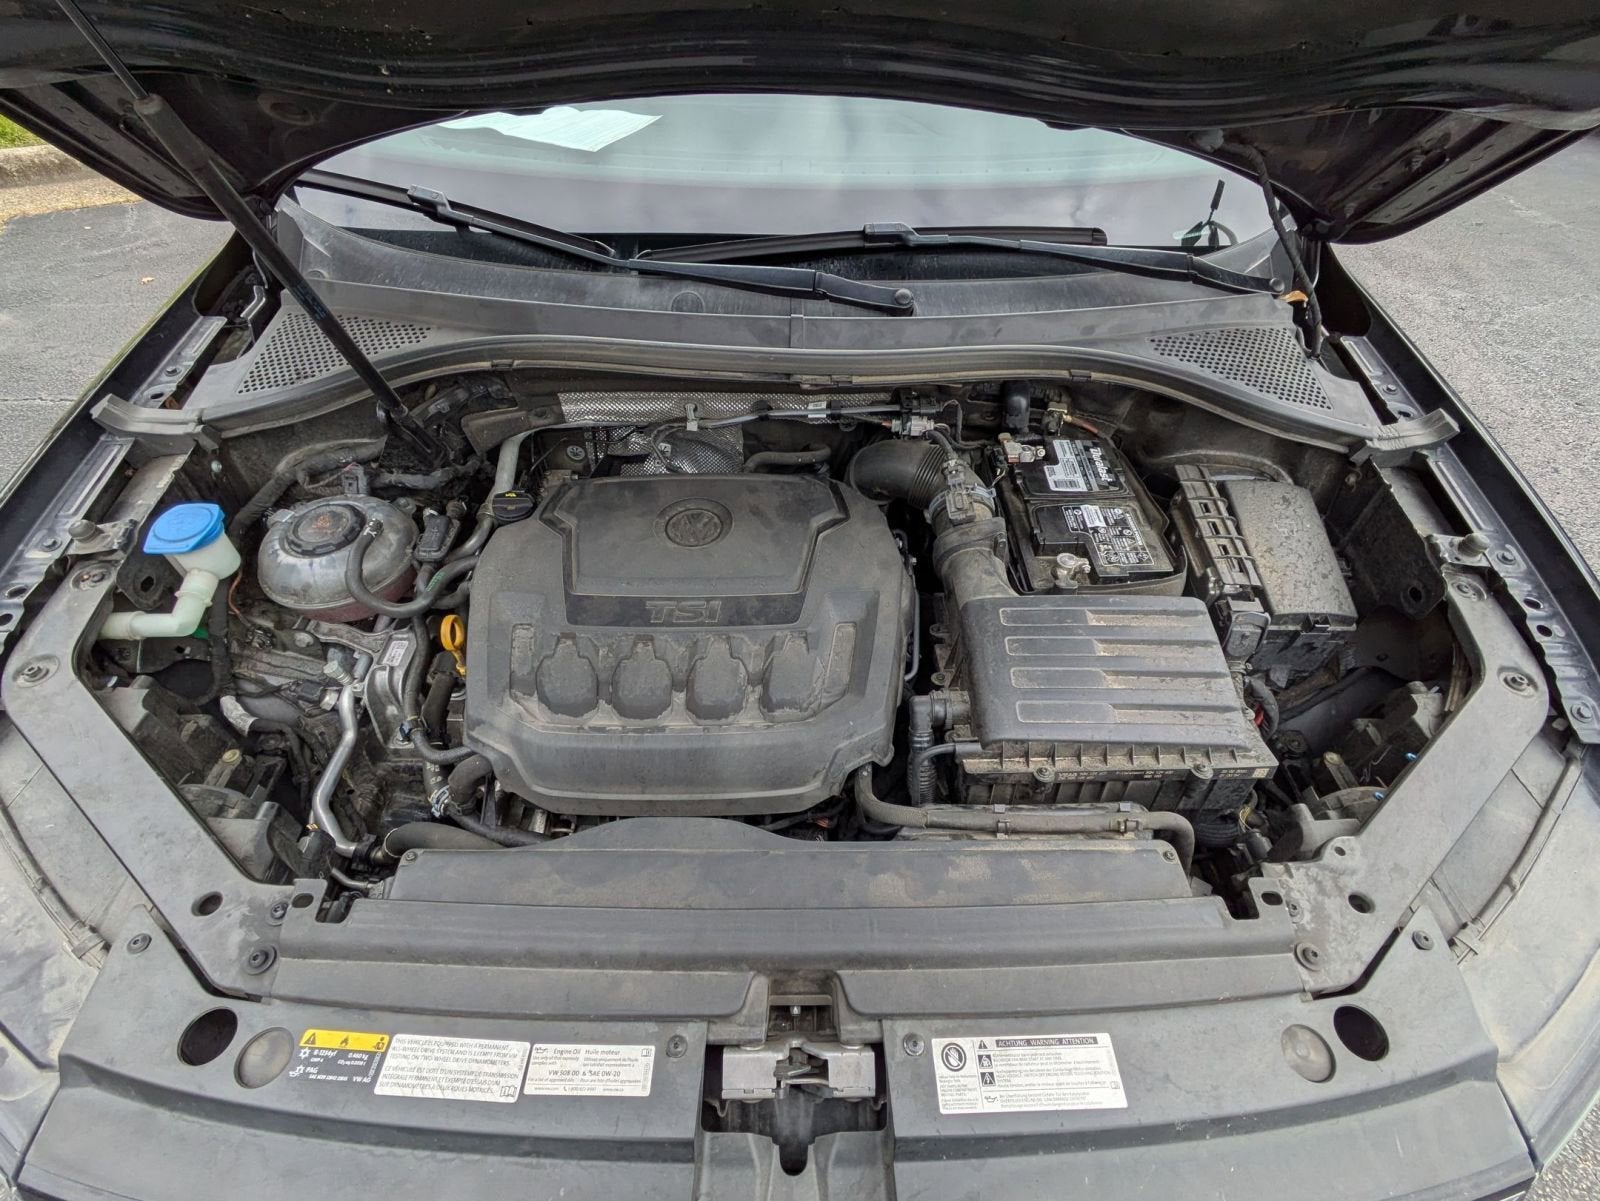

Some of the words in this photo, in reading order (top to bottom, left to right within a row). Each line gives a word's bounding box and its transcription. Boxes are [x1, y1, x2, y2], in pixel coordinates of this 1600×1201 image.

[1090, 447, 1112, 481] Duralast
[645, 601, 721, 622] TSI
[998, 1039, 1027, 1047] ACHTUNG
[1030, 1038, 1060, 1046] WARNING
[1062, 1037, 1095, 1045] ATTENTION
[553, 1048, 572, 1056] Engine
